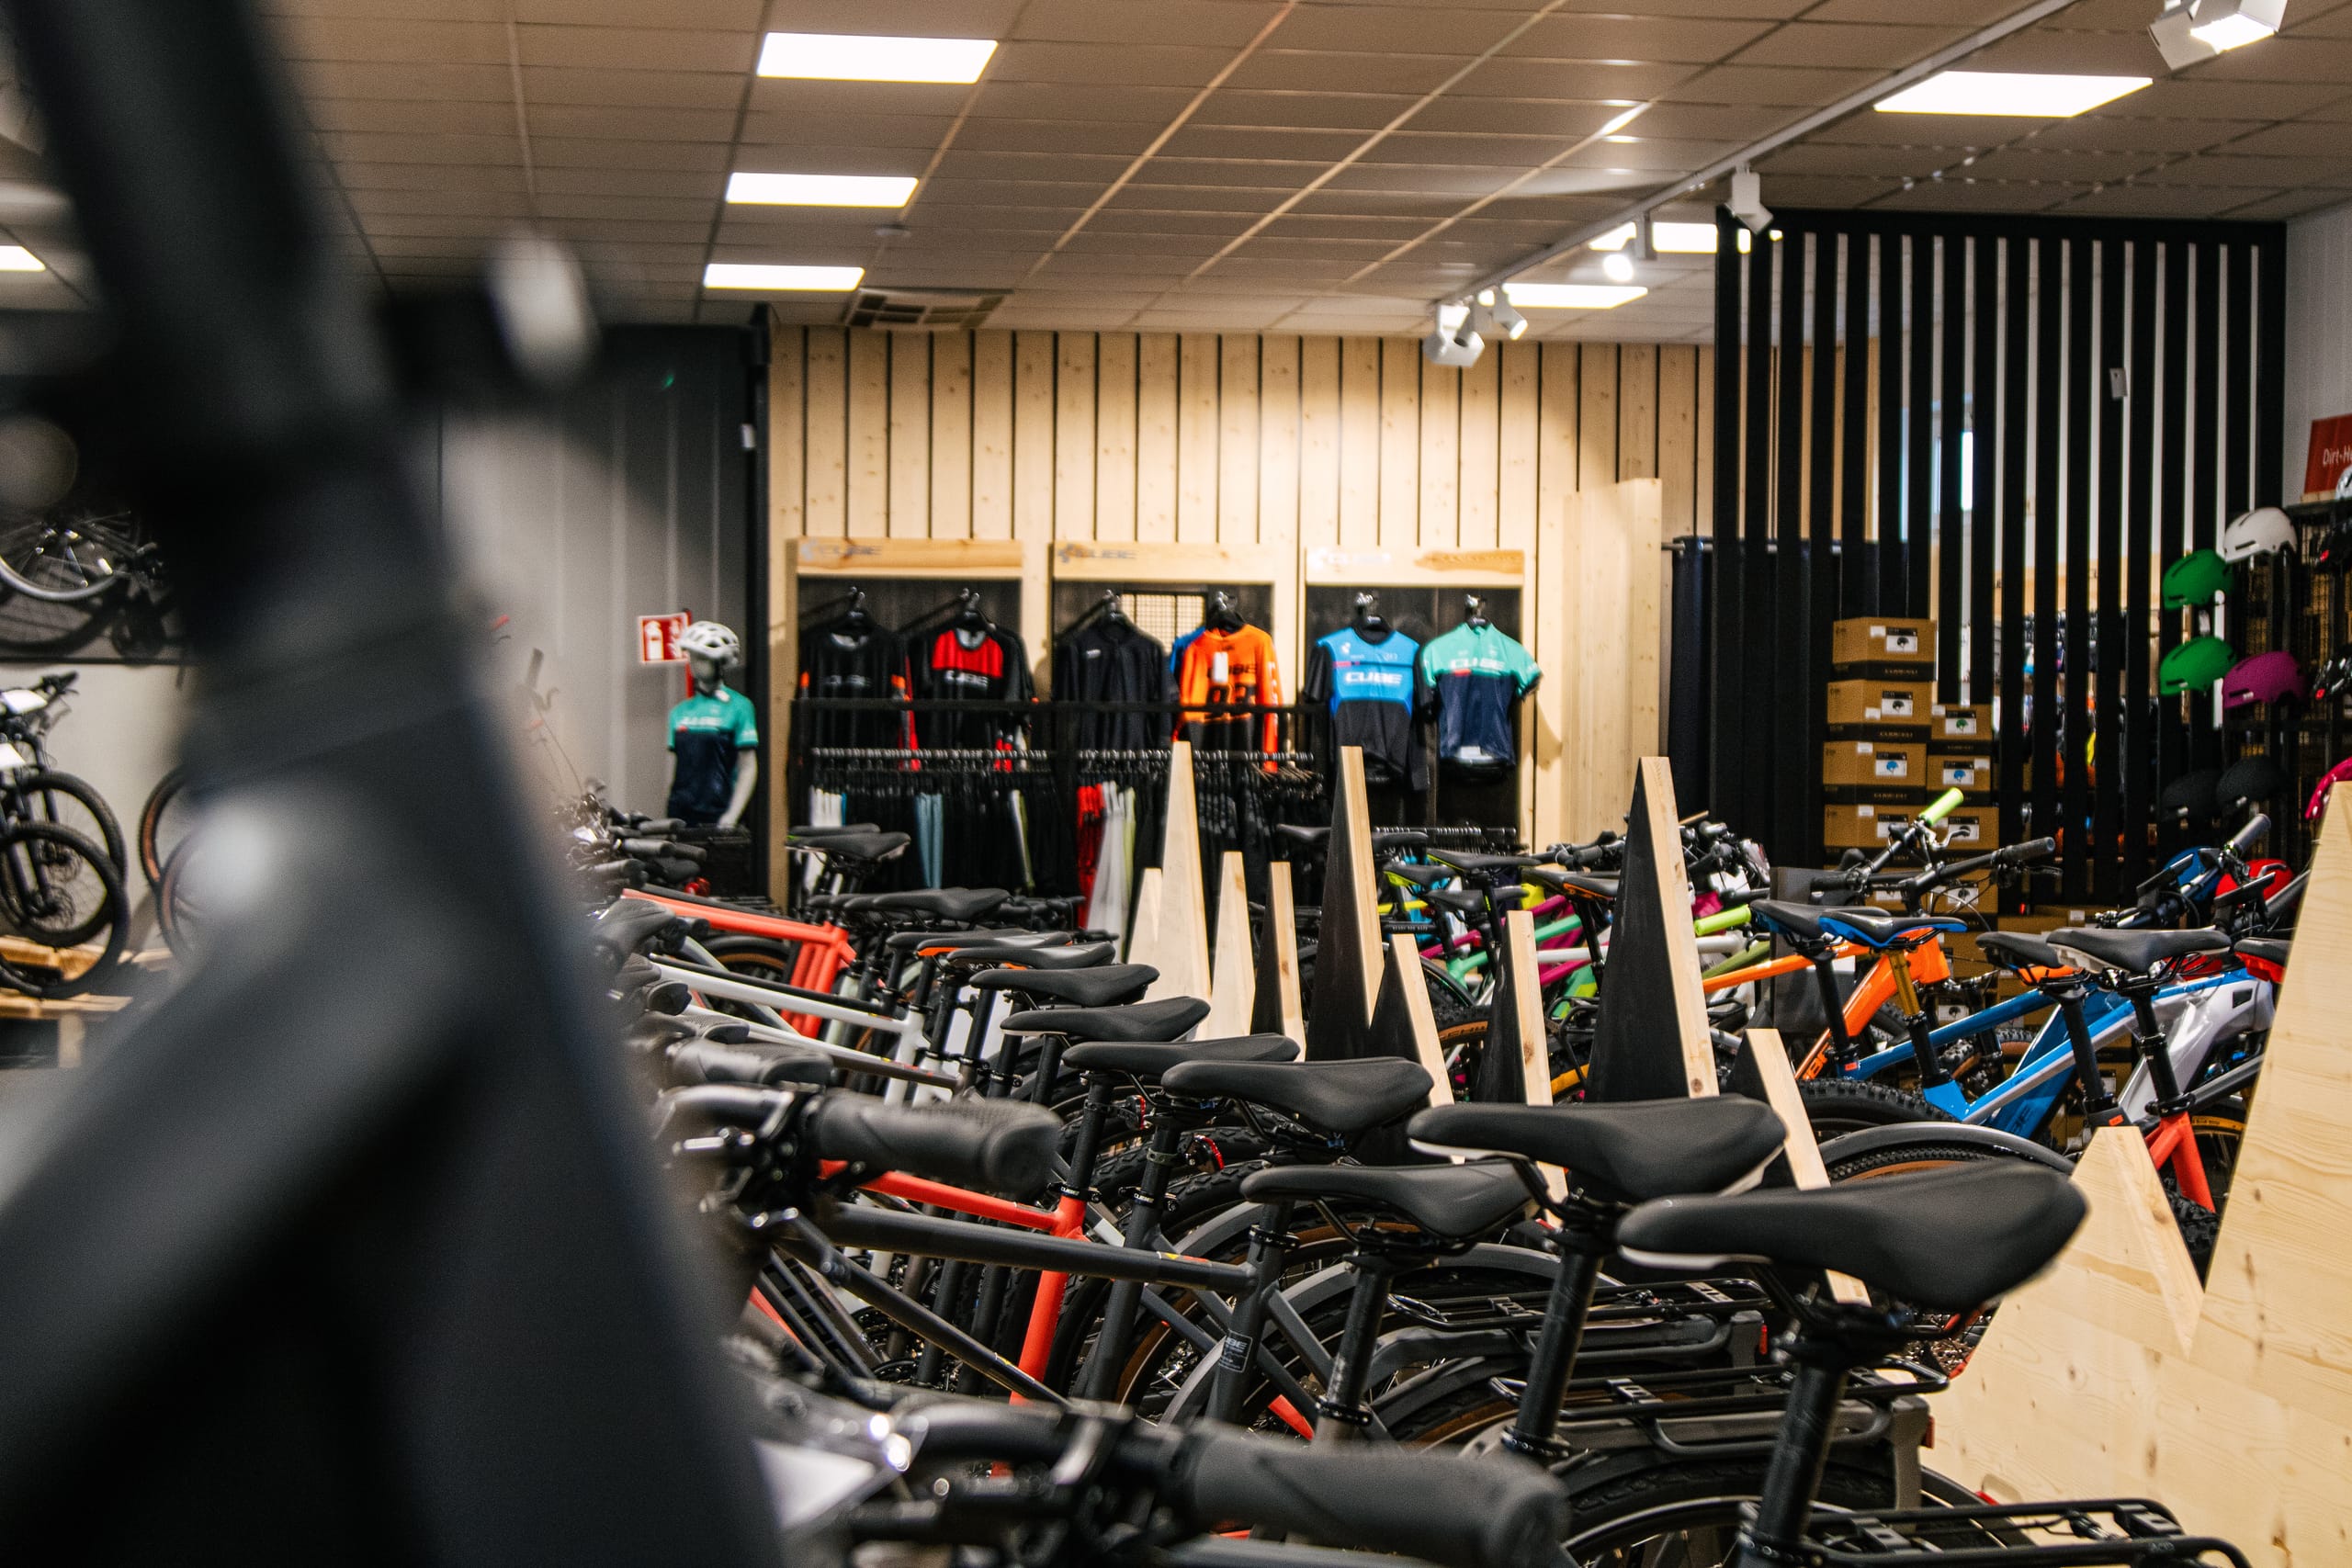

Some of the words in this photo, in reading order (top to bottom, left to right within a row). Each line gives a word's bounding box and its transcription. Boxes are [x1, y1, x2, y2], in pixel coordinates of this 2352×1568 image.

[2323, 446, 2352, 467] Dirt-H
[1343, 671, 1403, 687] CUBE
[1060, 1185, 1080, 1196] CUBE
[1133, 1192, 1155, 1204] CUBE
